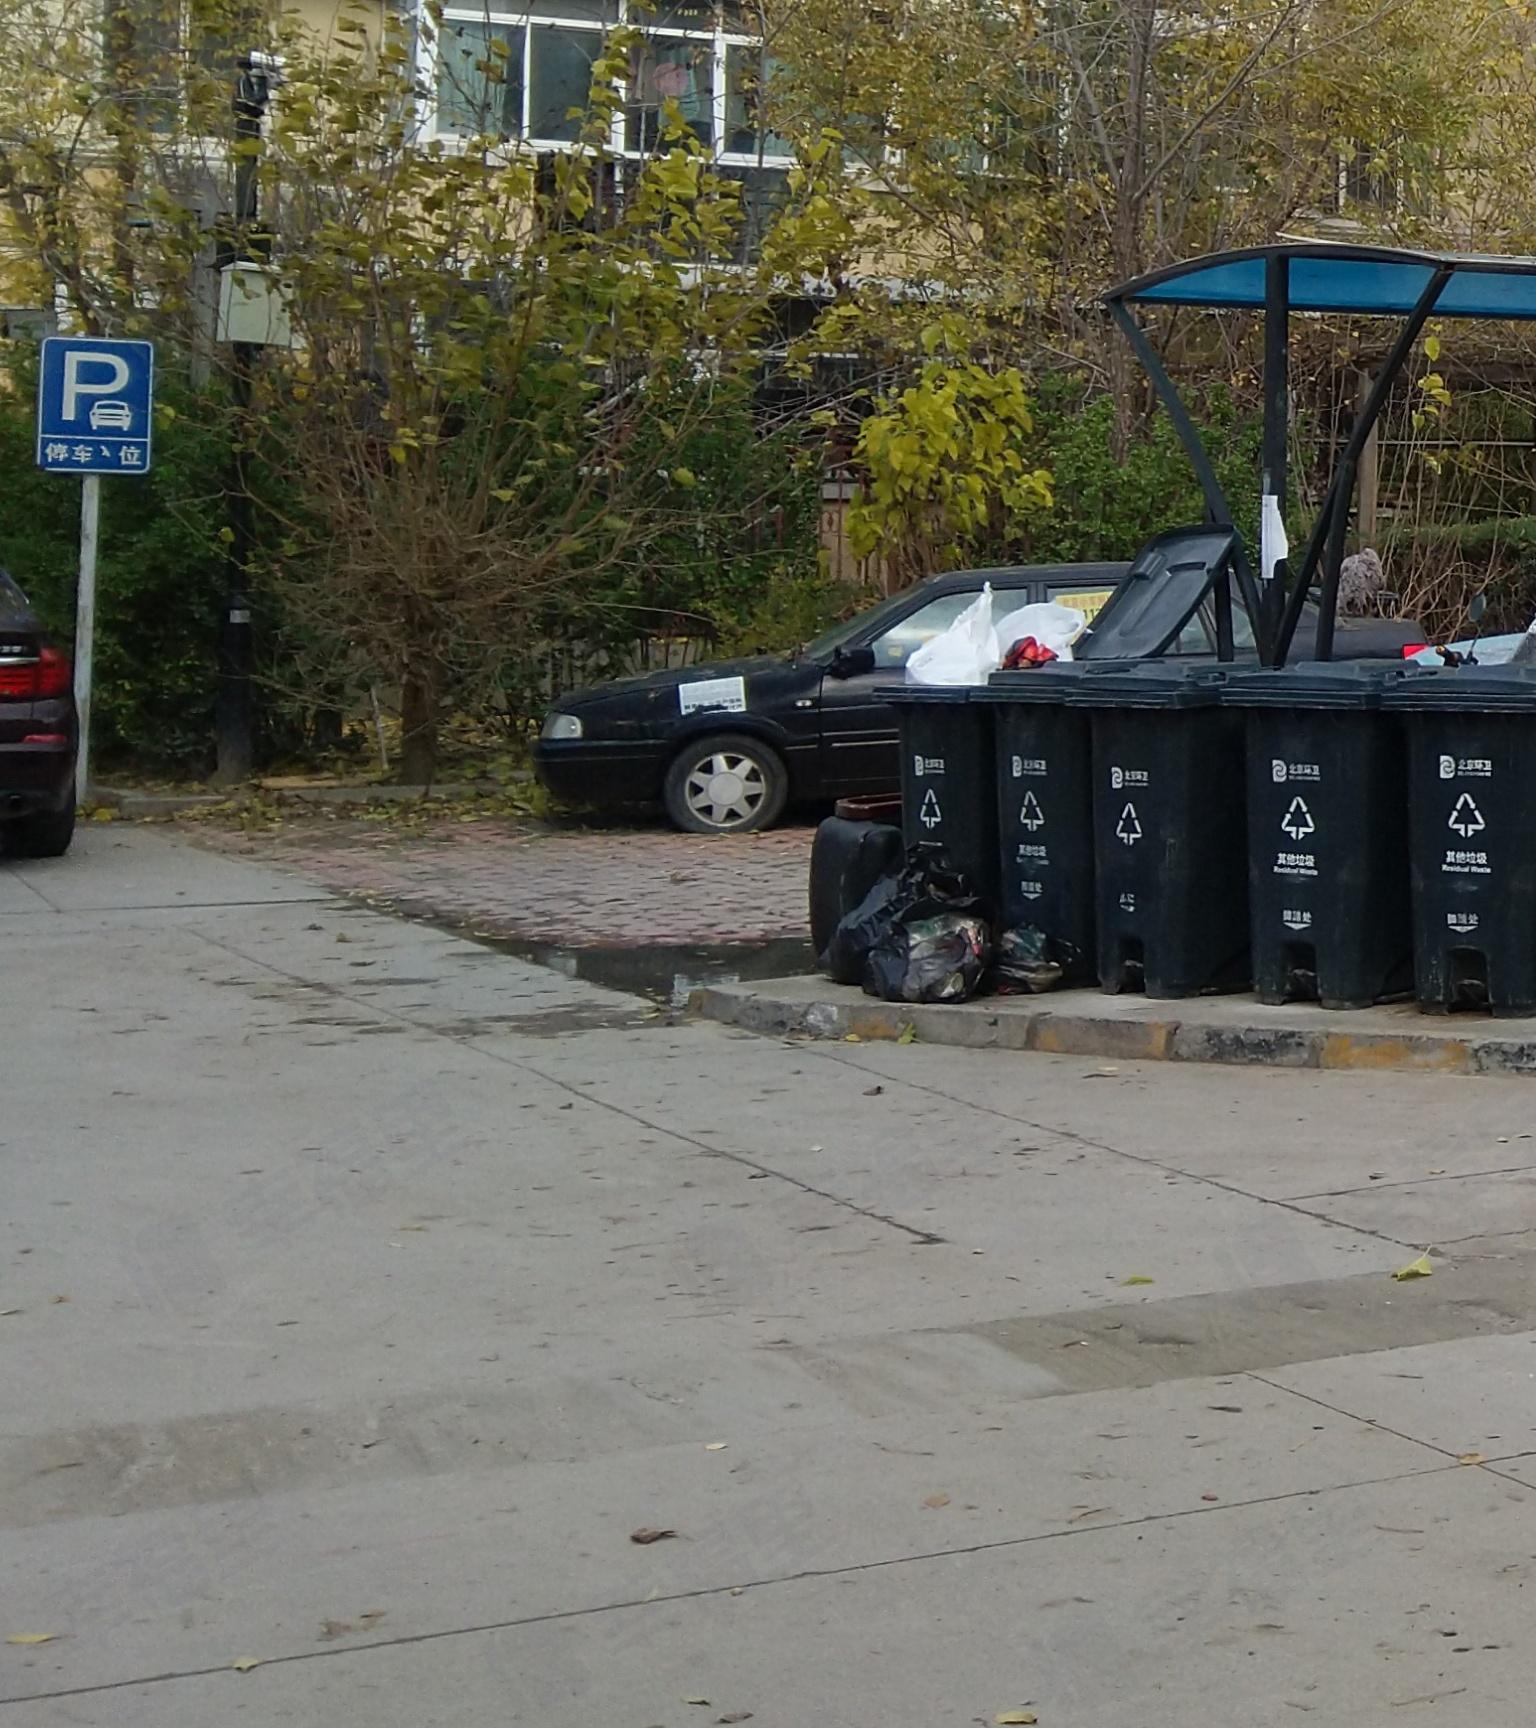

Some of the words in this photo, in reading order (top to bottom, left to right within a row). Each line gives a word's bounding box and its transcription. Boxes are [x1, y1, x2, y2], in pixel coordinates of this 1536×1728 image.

[61, 351, 130, 421] P
[1277, 853, 1315, 866] 其他垃圾
[1446, 851, 1488, 864] 其他垃圾
